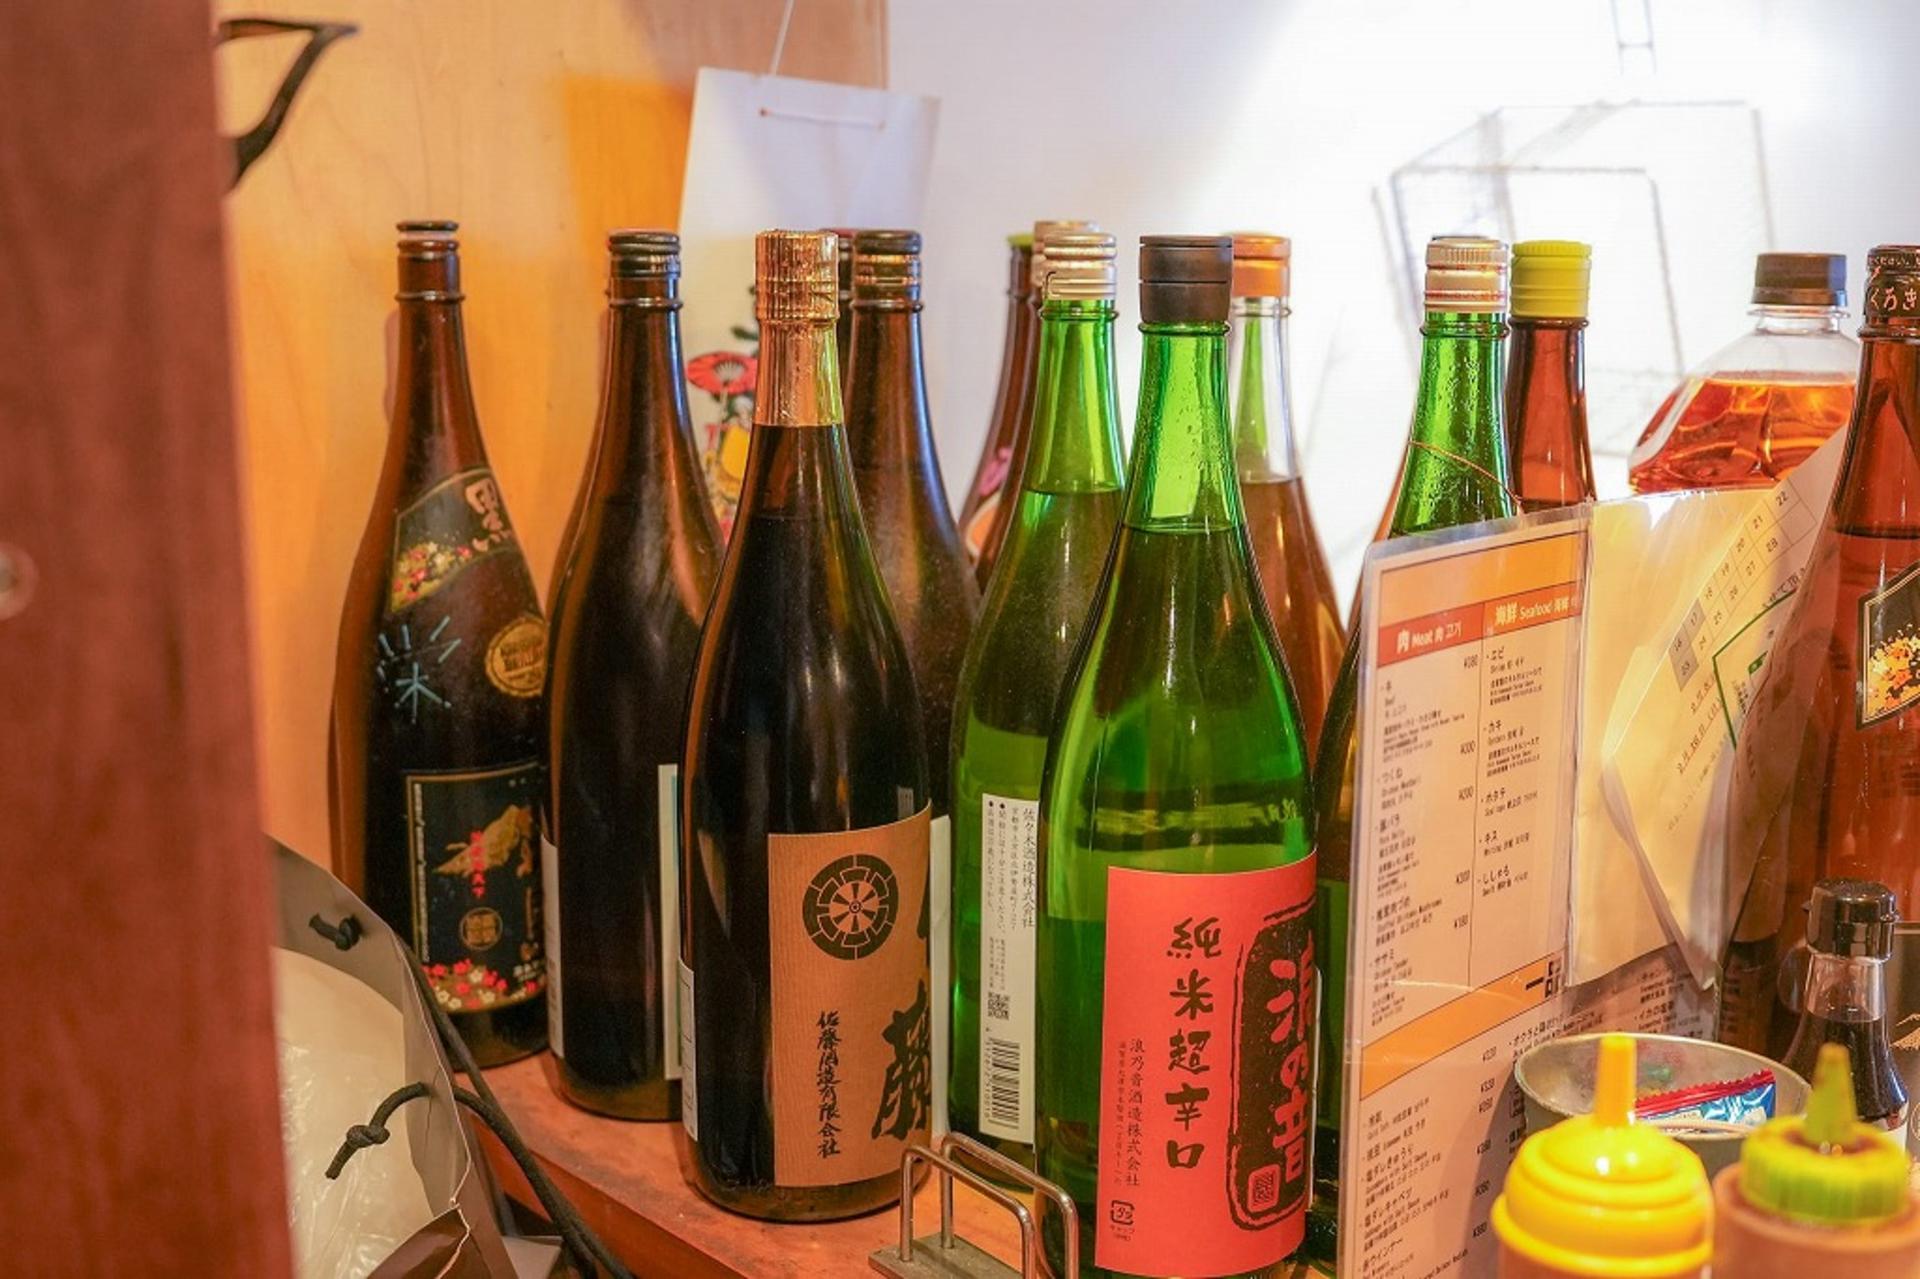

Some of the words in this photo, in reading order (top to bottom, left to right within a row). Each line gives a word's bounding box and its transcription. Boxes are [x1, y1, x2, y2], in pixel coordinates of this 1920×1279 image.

[1753, 515, 1763, 529] 21
[1776, 491, 1788, 507] 22
[1766, 537, 1778, 553] 28
[1495, 602, 1517, 626] 海鮮
[1520, 599, 1552, 620] Seafood
[1396, 629, 1410, 654] 肉
[1411, 629, 1433, 648] Meat
[1022, 807, 1037, 929] 佐々木酒造株式会社
[1164, 916, 1223, 1170] 純米超辛口
[1126, 1037, 1145, 1188] 浪乃音酒造株式会社
